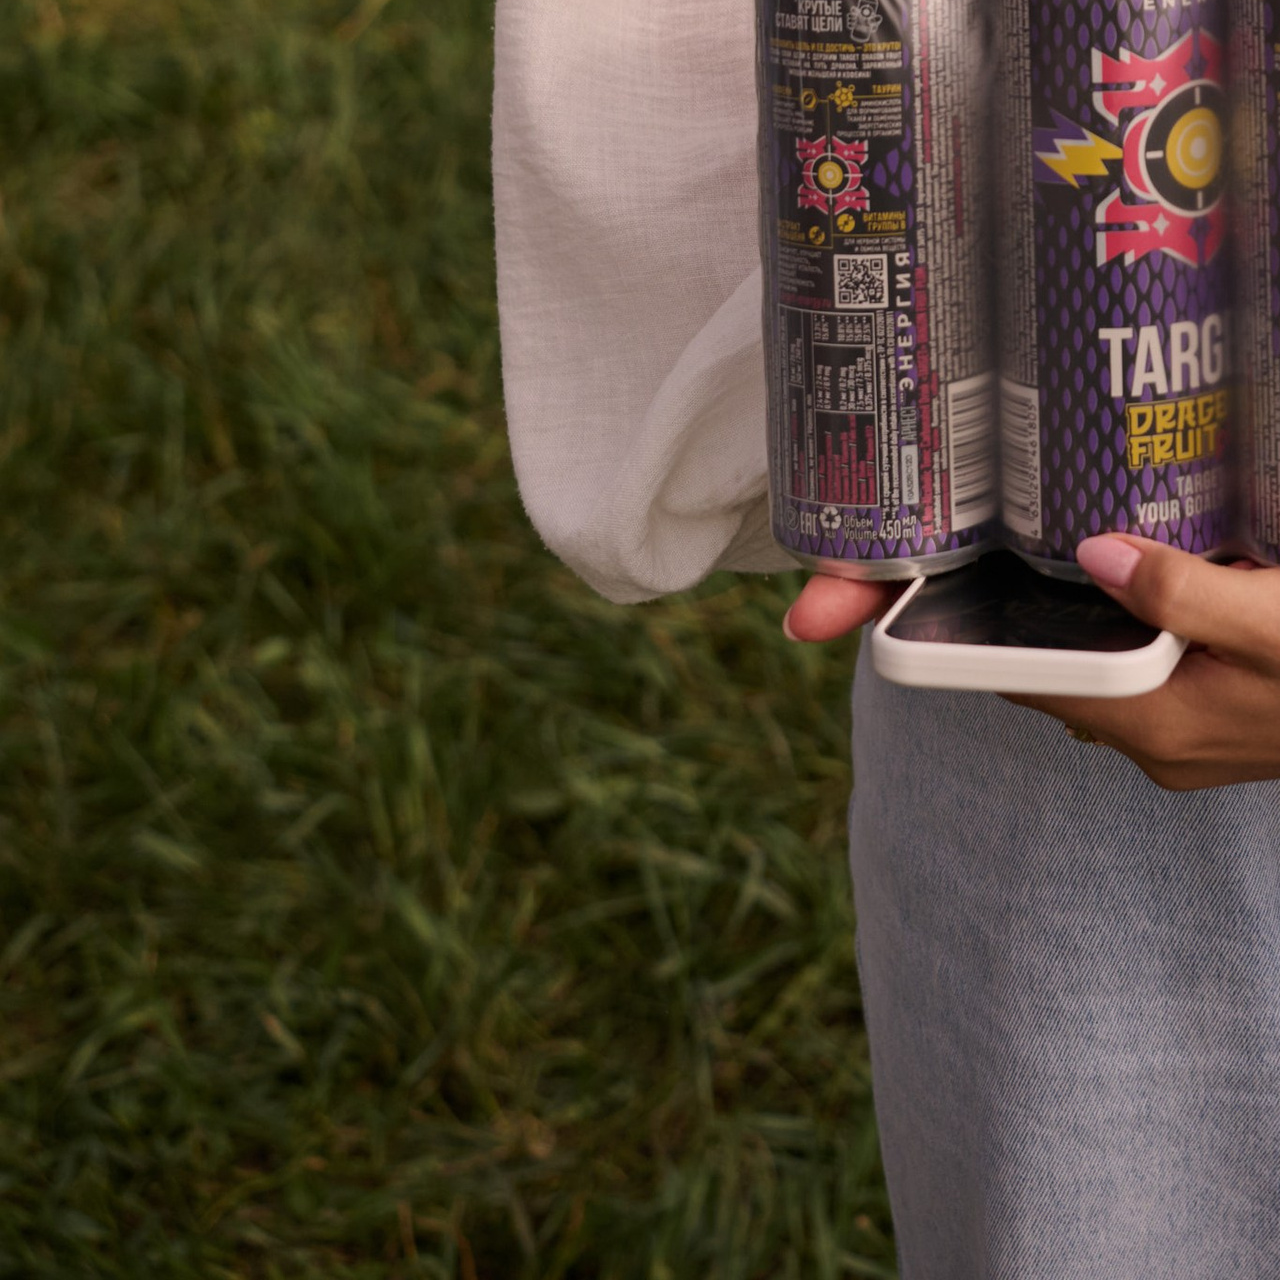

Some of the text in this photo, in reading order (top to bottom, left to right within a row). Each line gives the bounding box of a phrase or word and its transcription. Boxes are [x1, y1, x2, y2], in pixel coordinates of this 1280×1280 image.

[775, 12, 843, 33] СТАВЯТ ЦЕЛИ
[872, 83, 901, 94] ТАУРИН
[863, 211, 906, 221] ВИТАМИНЫ
[868, 221, 899, 231] ГРУППЫ
[1129, 424, 1217, 466] FRUIT
[1137, 499, 1180, 524] YOUR
[843, 516, 873, 527] Объем
[902, 516, 916, 525] мл
[844, 528, 877, 540] Volume
[879, 519, 900, 539] 450
[902, 527, 916, 537] ml
